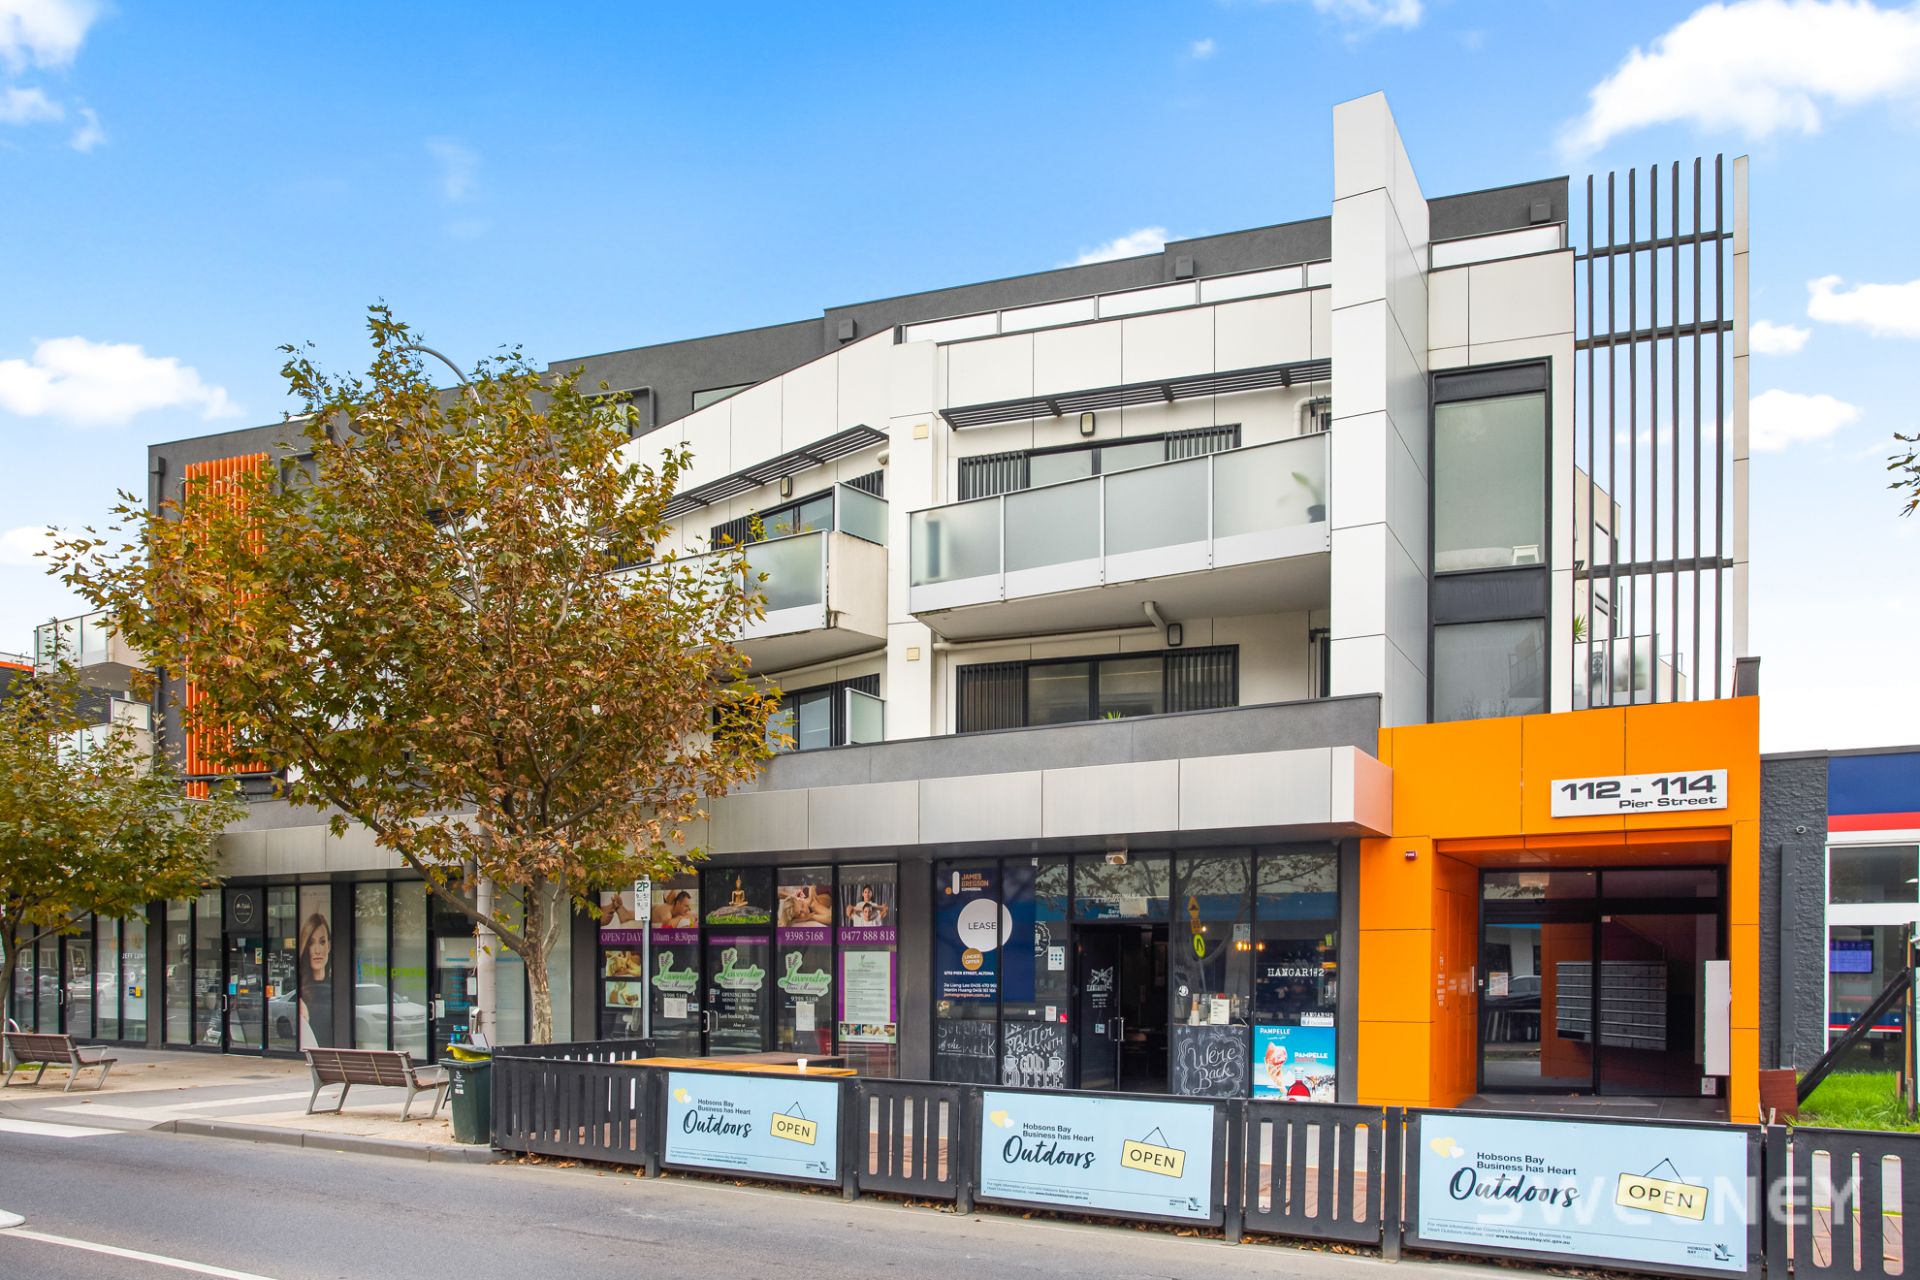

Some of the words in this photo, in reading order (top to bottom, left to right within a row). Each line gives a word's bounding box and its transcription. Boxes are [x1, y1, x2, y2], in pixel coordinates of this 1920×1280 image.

[1561, 781, 1620, 800] 112
[1652, 775, 1716, 795] 114
[1619, 800, 1652, 808] Pier
[1658, 796, 1717, 807] Street
[636, 882, 649, 892] 2P
[968, 922, 997, 930] LEASE
[601, 932, 620, 942] OPEN
[622, 932, 626, 942] 7
[627, 932, 641, 942] DAY
[785, 931, 804, 940] 9398
[806, 931, 824, 940] 5168
[842, 931, 860, 940] 0477
[863, 931, 878, 940] 888
[880, 931, 895, 940] 818
[1193, 1061, 1234, 1093] Back
[683, 1110, 752, 1138] Outdoors
[777, 1121, 810, 1137] OPEN
[1023, 1123, 1055, 1132] Hobsons
[1057, 1125, 1071, 1133] Bay
[1023, 1130, 1056, 1140] Business
[1073, 1134, 1094, 1142] Heart
[1002, 1135, 1096, 1169] Outdoors
[1130, 1149, 1176, 1169] OPEN
[1477, 1152, 1522, 1162] Hobsons
[1525, 1155, 1544, 1165] Bay
[1477, 1161, 1523, 1172] Business
[1526, 1164, 1544, 1173] has
[1547, 1166, 1577, 1176] Heart
[1449, 1167, 1580, 1208] Outdoors
[1628, 1184, 1694, 1210] OPEN
